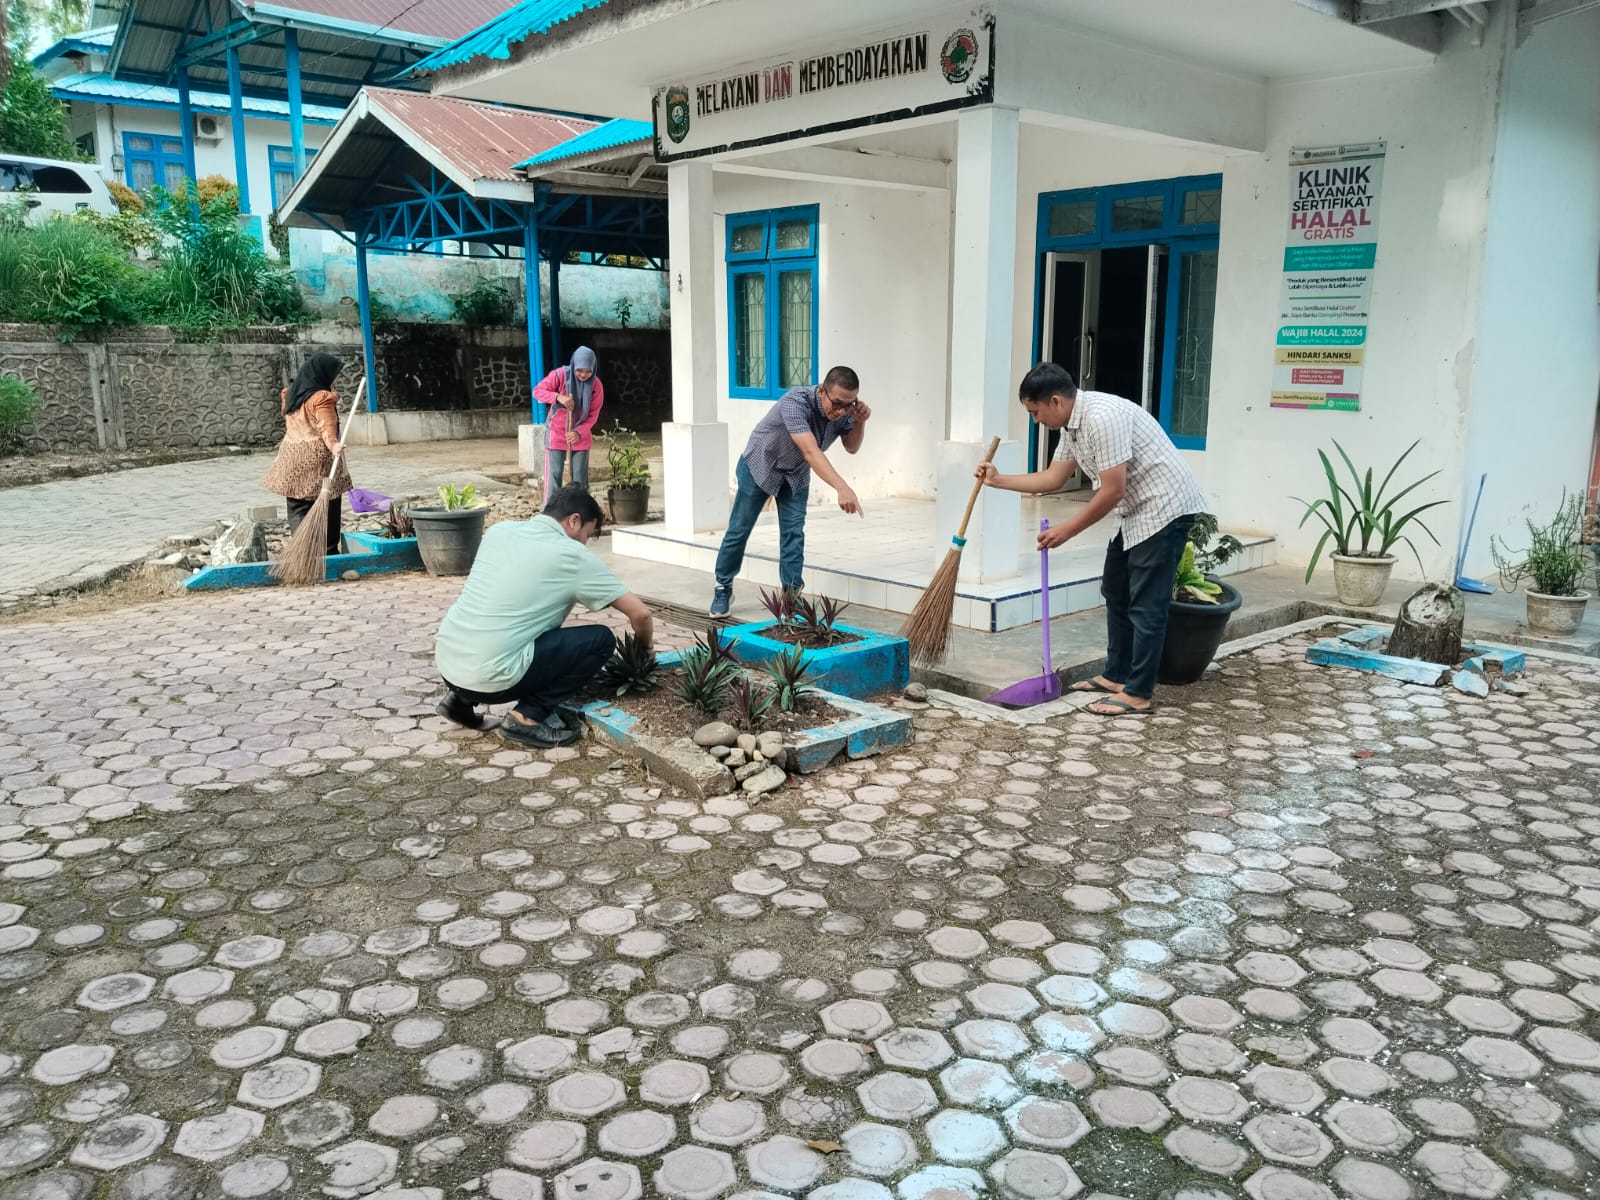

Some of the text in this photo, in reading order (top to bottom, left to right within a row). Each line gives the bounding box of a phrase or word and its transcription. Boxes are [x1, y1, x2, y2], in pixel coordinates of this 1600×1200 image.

[697, 34, 928, 116] MELAYANI DAN MEMBERDAYAKAN
[1299, 165, 1372, 188] KLINIK
[1299, 184, 1367, 200] LAYANAN
[1292, 195, 1374, 212] SERTIFIKAT
[1291, 208, 1371, 230] HALAL
[1303, 227, 1355, 240] GRATIS
[1281, 328, 1363, 338] WAJIB HALAL 2024
[1287, 351, 1352, 360] HINDARI SANKSI
